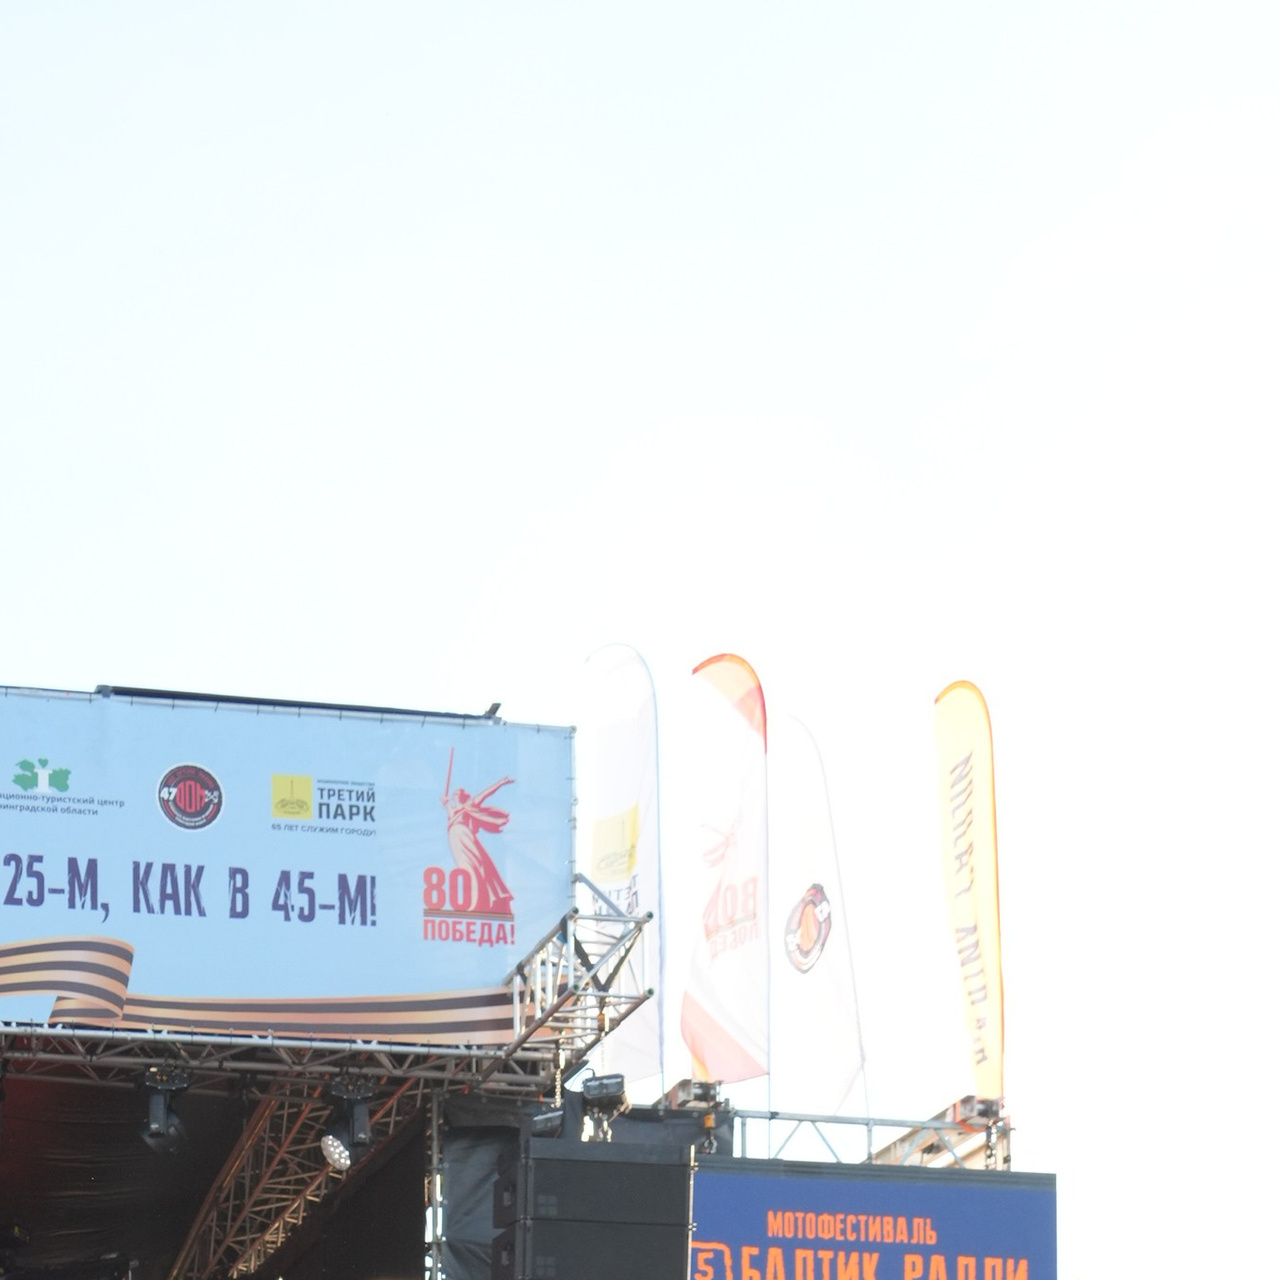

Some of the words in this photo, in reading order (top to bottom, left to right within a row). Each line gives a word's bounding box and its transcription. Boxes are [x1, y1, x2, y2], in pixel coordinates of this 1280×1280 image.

[97, 798, 125, 808] центр
[160, 787, 177, 800] 47
[317, 786, 376, 803] ТРЕТИЙ
[60, 805, 99, 816] области
[318, 802, 376, 822] ПАРК
[132, 860, 207, 918] КАК
[228, 866, 250, 920] В
[423, 866, 473, 912] 80
[423, 918, 516, 948] ПОБЕДА!
[767, 1210, 937, 1245] МОТОФЕСТИВАЛЬ
